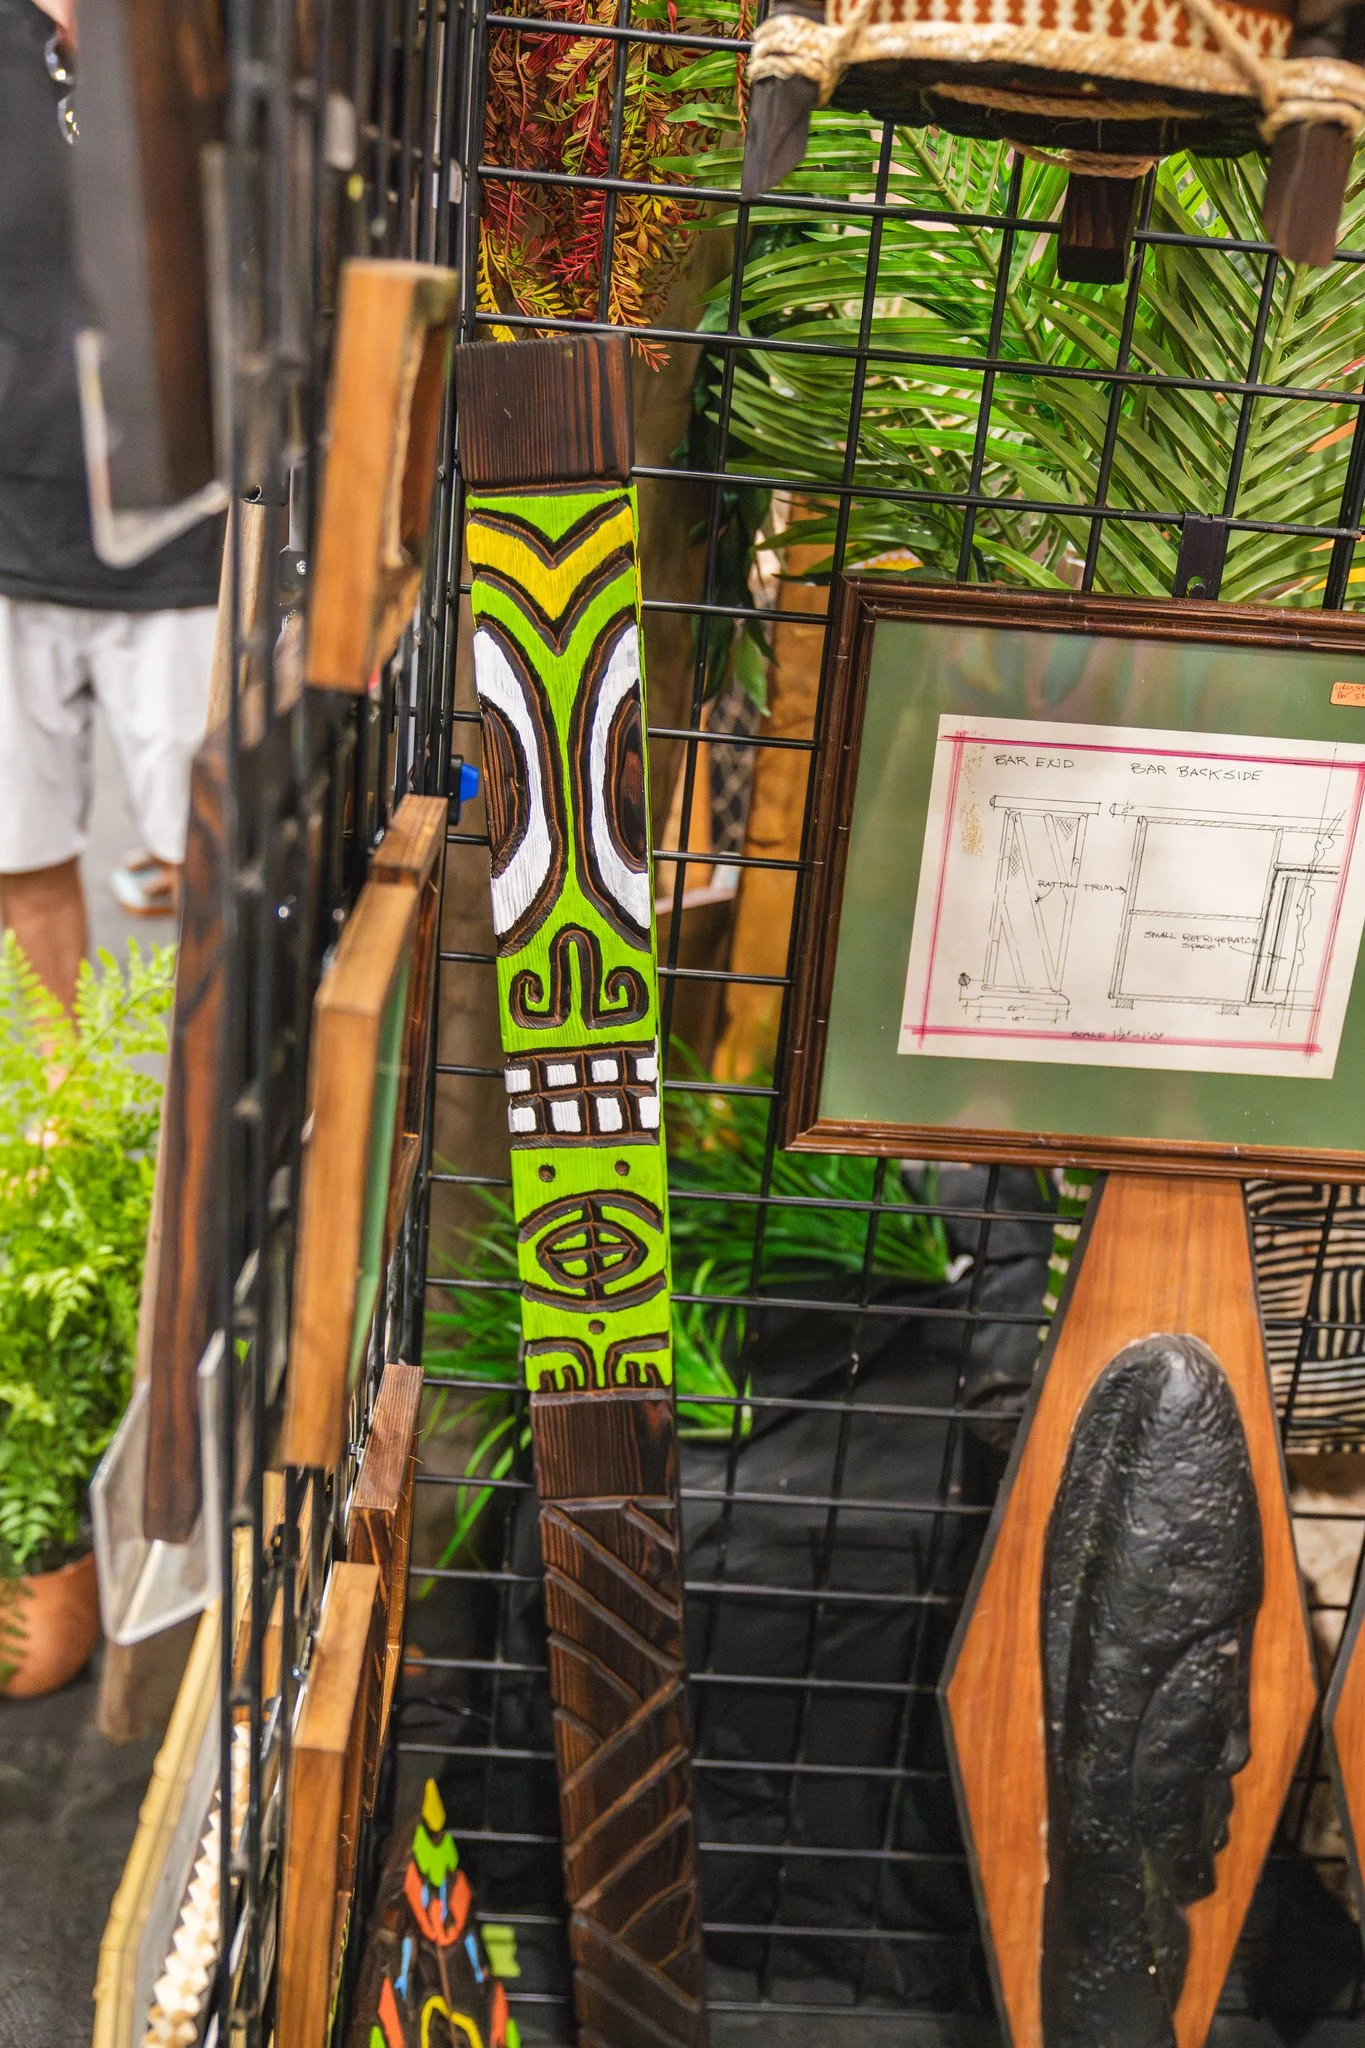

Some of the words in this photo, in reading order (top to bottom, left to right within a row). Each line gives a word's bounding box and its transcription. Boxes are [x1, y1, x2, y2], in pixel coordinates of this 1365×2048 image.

[993, 755, 1028, 766] BAR
[1131, 763, 1167, 775] BAR
[1177, 765, 1263, 781] BACKSIDE
[1083, 884, 1114, 892] TRIM
